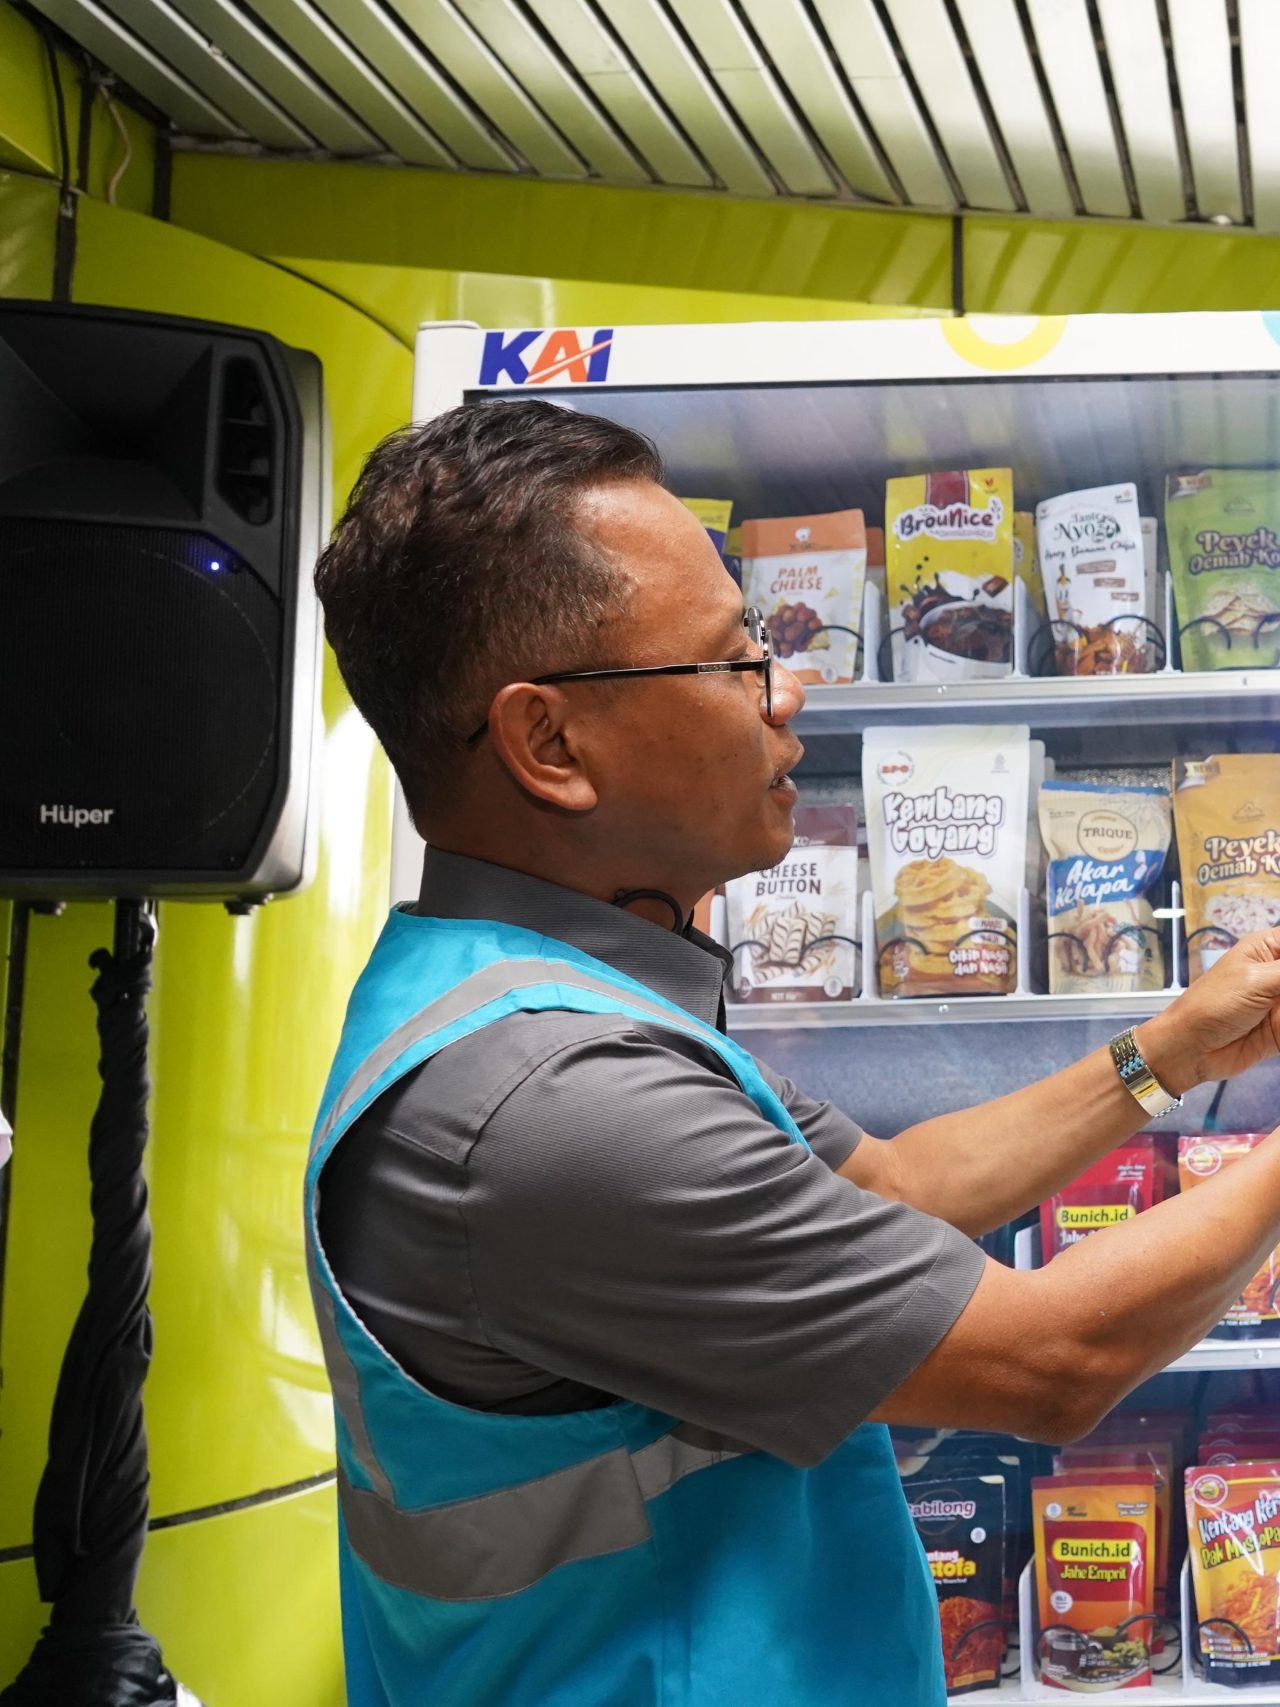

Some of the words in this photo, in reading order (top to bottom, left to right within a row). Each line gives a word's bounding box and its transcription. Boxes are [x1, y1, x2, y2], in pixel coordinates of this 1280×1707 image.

[479, 329, 613, 385] KAI
[1197, 527, 1278, 555] Peyek
[778, 565, 818, 579] PALM
[770, 577, 823, 594] CHEESE
[882, 786, 1002, 825] Kembang
[41, 804, 114, 828] Hüper
[891, 823, 995, 859] Goyang
[1083, 827, 1133, 840] TRIQUE
[759, 863, 818, 878] CHEESE
[1067, 860, 1124, 885] Akar
[756, 880, 821, 897] BUTTON
[1055, 877, 1135, 908] Kelapa
[1061, 1209, 1128, 1223] Bunich.id
[909, 1501, 975, 1518] abilong
[1199, 1509, 1255, 1545] Kentang
[1061, 1543, 1130, 1557] Bunich.id
[1201, 1542, 1223, 1569] Pak
[931, 1558, 976, 1577] stofa
[1060, 1564, 1087, 1580] Jahe
[1088, 1564, 1127, 1582] Emprit
